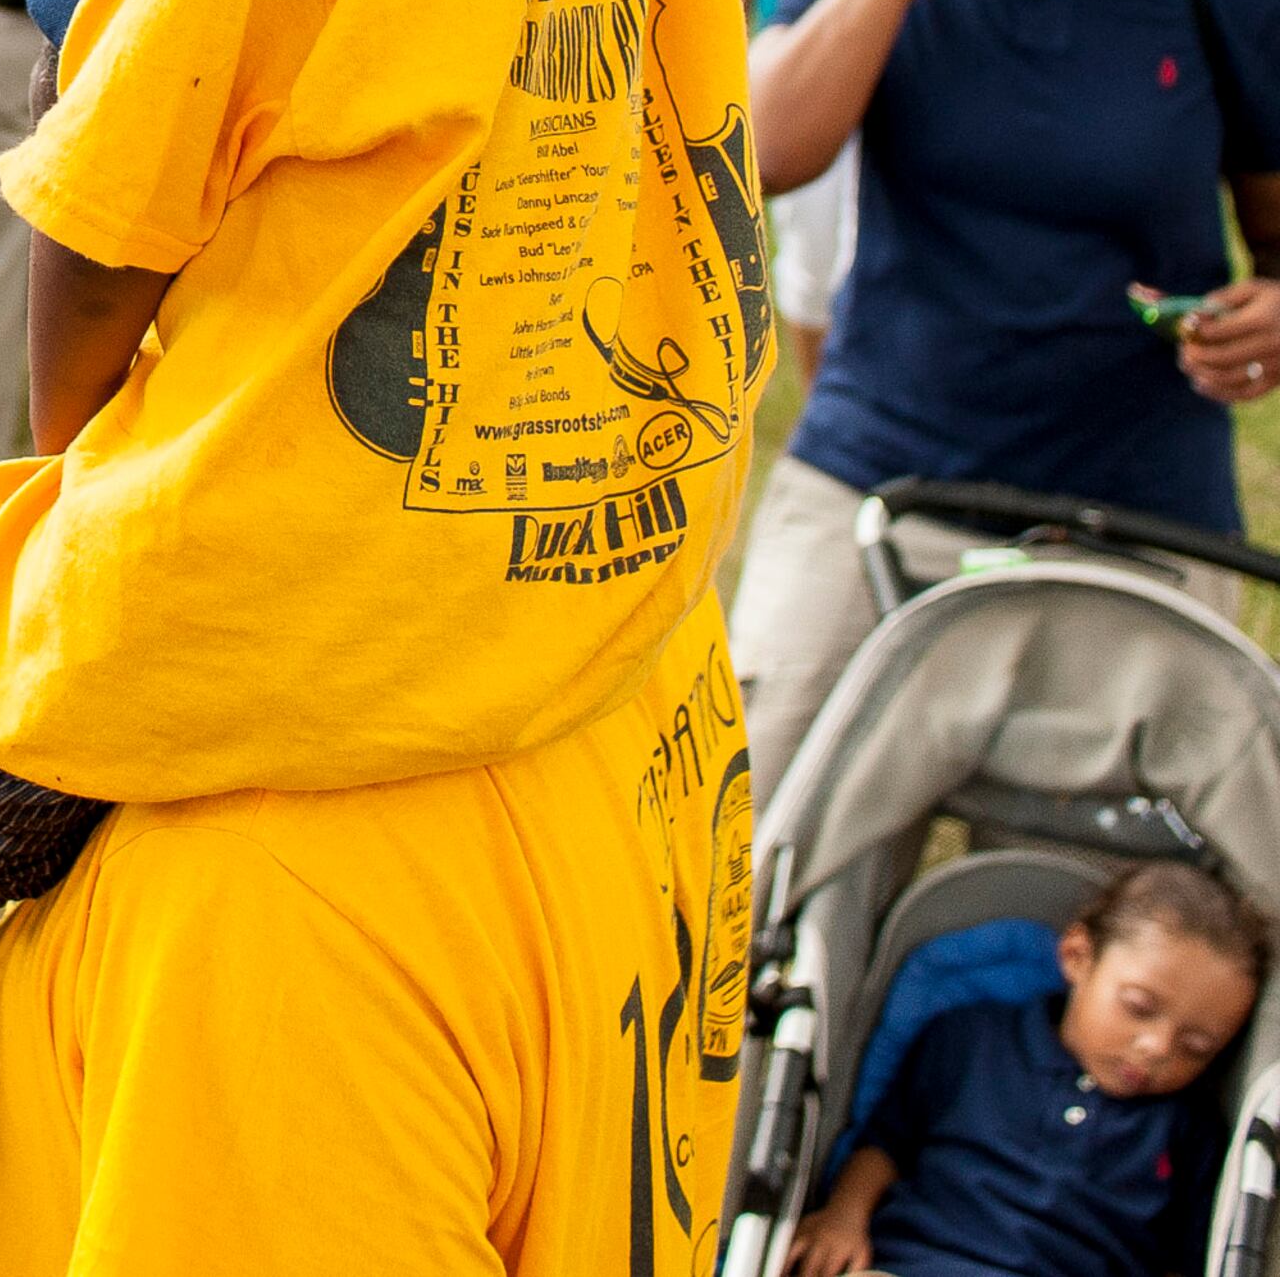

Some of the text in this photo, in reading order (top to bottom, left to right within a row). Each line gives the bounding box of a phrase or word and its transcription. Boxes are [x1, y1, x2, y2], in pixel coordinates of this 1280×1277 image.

[551, 141, 580, 158] Abel
[517, 195, 552, 213] Danny
[568, 215, 577, 229] &
[518, 242, 545, 259] Bud
[671, 192, 693, 236] IN
[682, 238, 723, 307] THE
[441, 250, 464, 291] IN
[479, 269, 516, 287] Lewis
[434, 303, 462, 369] THE
[540, 386, 571, 403] Bonds
[419, 382, 461, 494] HILLS
[641, 420, 690, 460] ACER
[507, 476, 688, 566] Duck Hill
